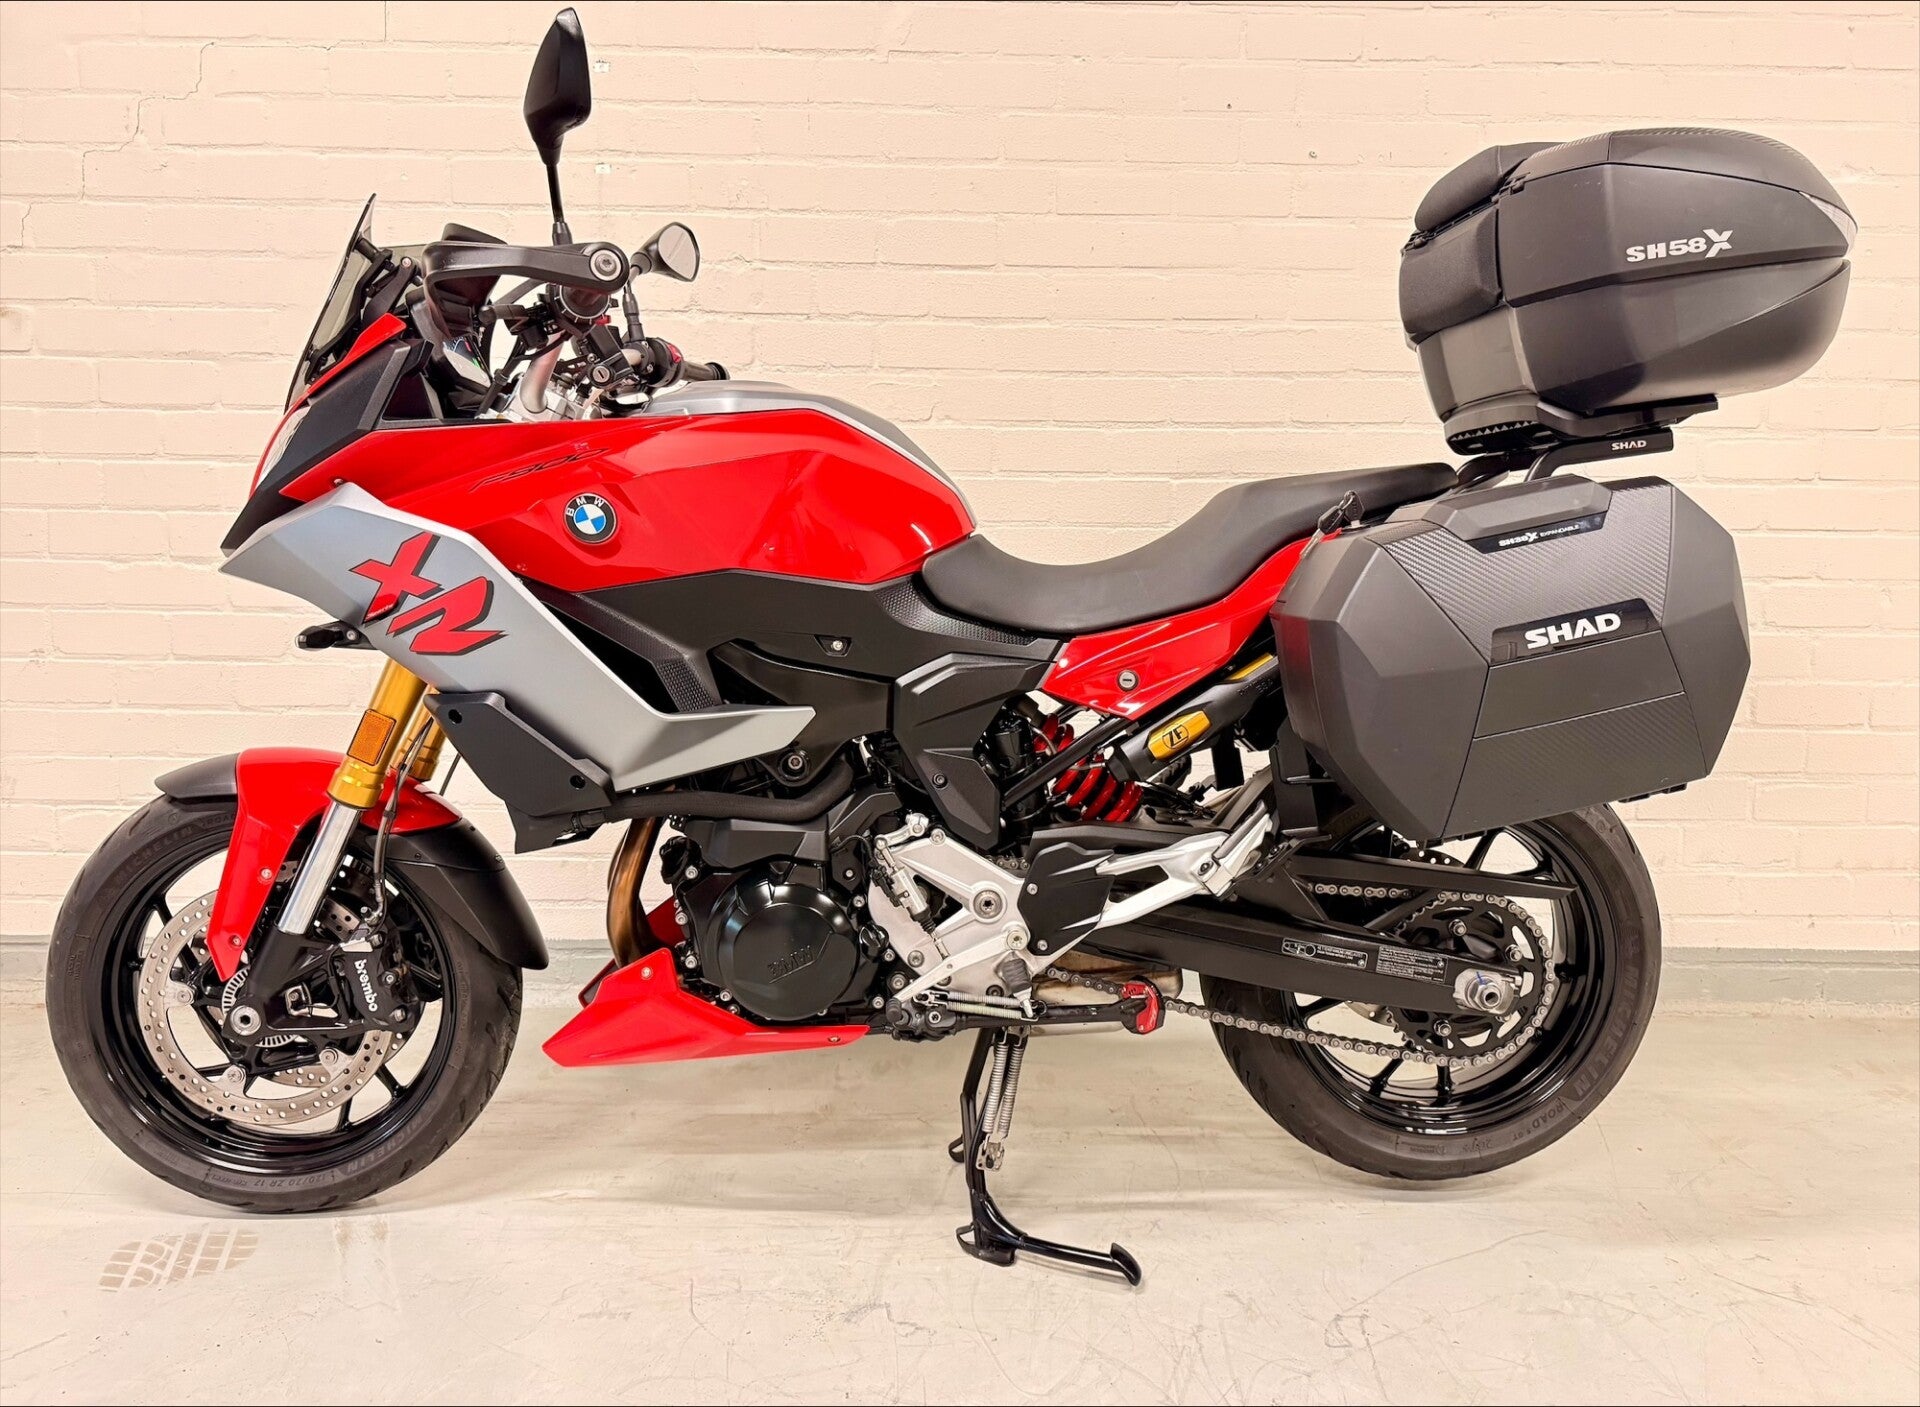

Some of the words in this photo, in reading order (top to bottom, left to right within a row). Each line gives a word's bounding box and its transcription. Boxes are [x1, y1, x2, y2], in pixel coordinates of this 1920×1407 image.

[1626, 228, 1733, 262] SH58X
[1611, 440, 1647, 451] SHAD
[566, 496, 605, 517] BMW
[1524, 613, 1622, 650] SHAD
[1162, 724, 1190, 748] ZF
[354, 959, 378, 1012] brembo
[1573, 966, 1640, 1097] MICHELIN
[1531, 1102, 1564, 1130] ROAD
[346, 1111, 426, 1173] MICHELIN
